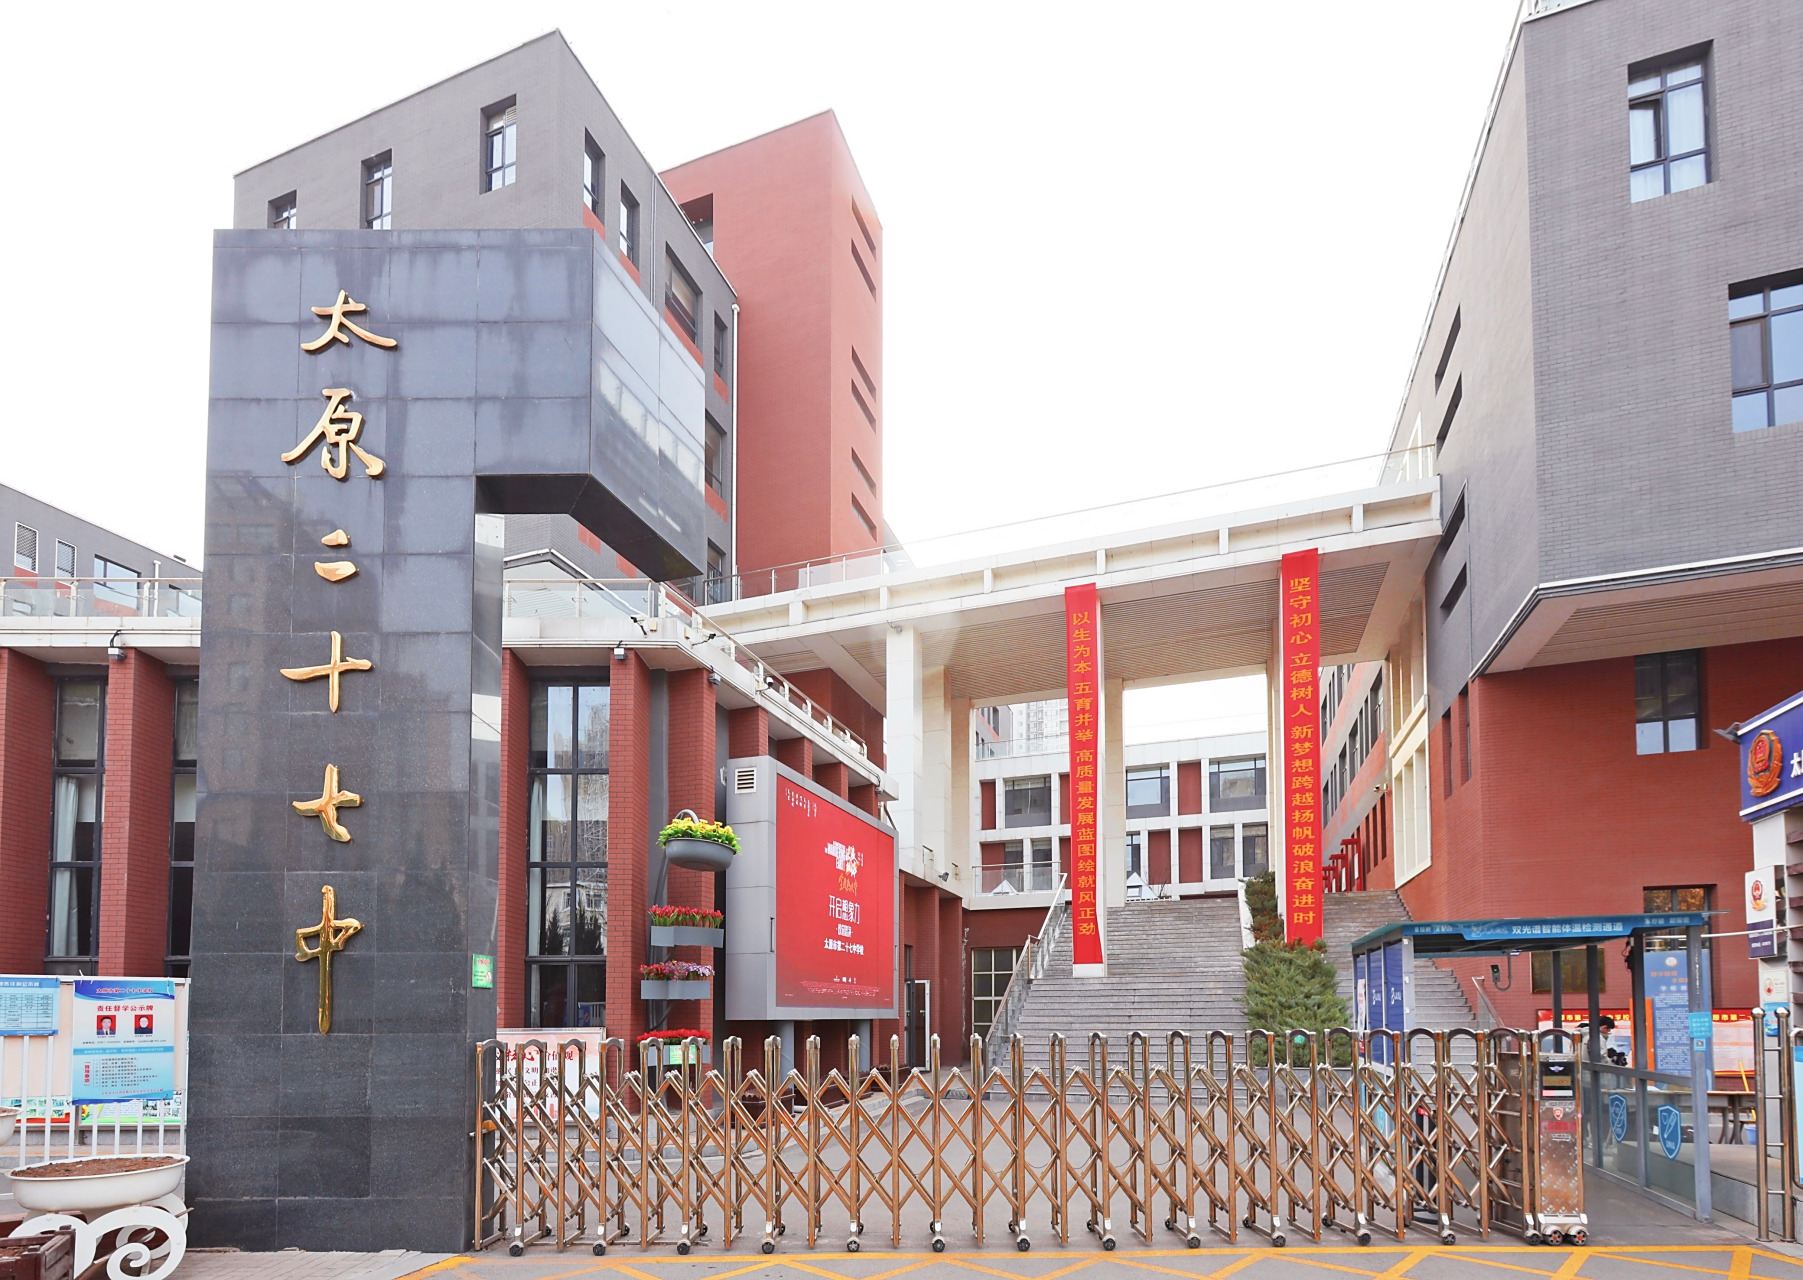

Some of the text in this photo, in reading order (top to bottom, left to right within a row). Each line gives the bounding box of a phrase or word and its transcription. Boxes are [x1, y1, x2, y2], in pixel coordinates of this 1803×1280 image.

[280, 288, 398, 1035] 太原二十七中
[1288, 576, 1316, 926] 坚守初心 立德树人 新梦想跨越扬帆破浪奋进时
[1790, 749, 1803, 778] 太
[1072, 612, 1097, 936] 以生为本 五育并举 高质量发展蓝图绘就风正劲
[828, 895, 860, 925] 开启想象力
[1512, 922, 1624, 934] 双光谱智能体温检测通道
[96, 1004, 154, 1012] 责任督学公示牌
